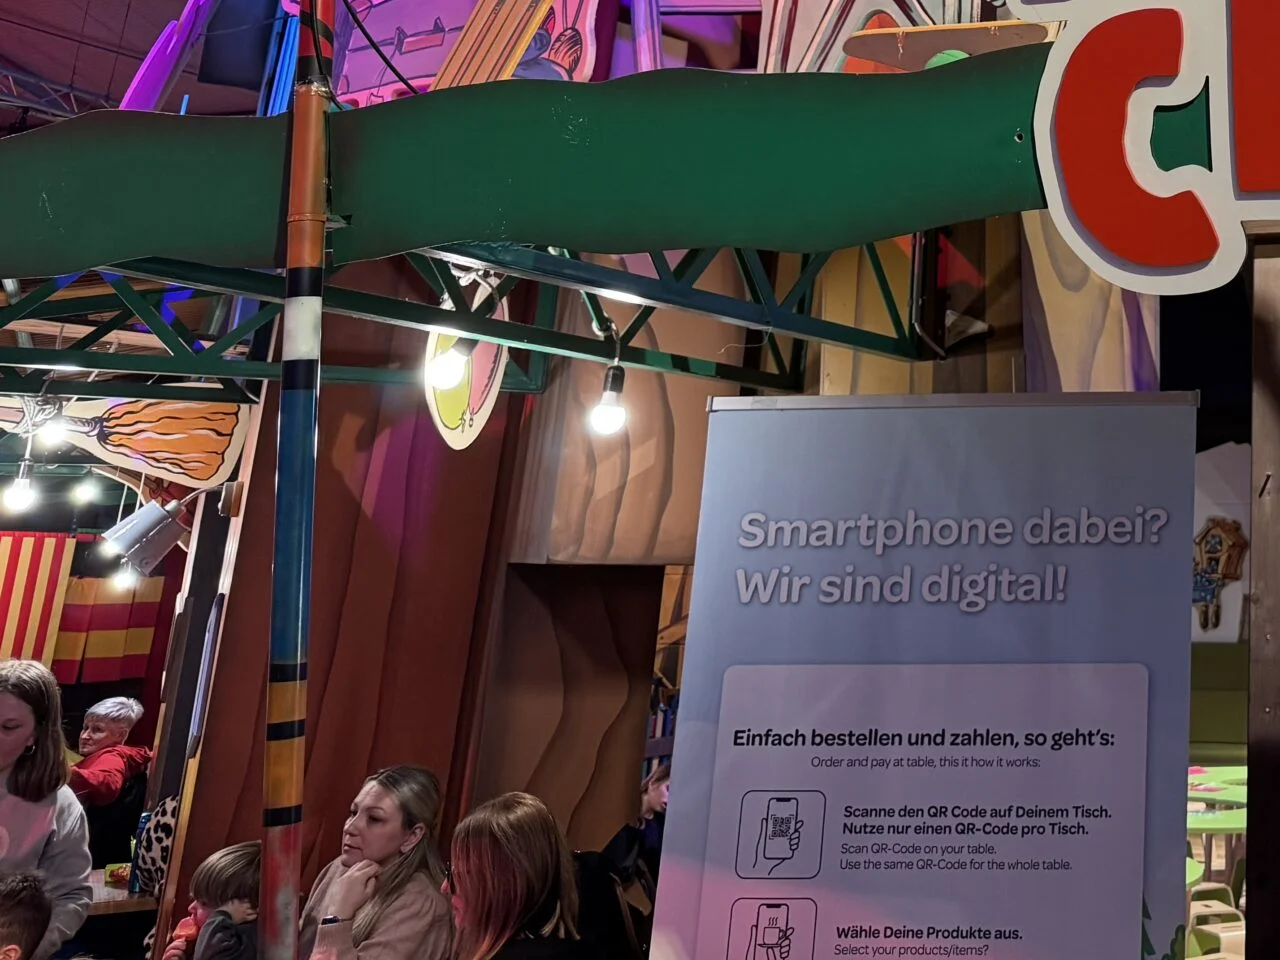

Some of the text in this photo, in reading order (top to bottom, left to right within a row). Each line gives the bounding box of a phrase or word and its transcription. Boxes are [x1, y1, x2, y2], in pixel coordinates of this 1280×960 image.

[738, 505, 1169, 556] Smartphone dabei?
[735, 562, 1068, 613] Wir sind digital!
[733, 728, 807, 747] Einfach
[811, 728, 903, 747] bestellen
[907, 728, 946, 747] und
[949, 728, 1020, 749] zahlen,
[1023, 732, 1048, 747] so
[811, 755, 1041, 770] Order and pay at table, this it how it works:
[843, 805, 1112, 819] Scanne den QR Code auf Deinem Tisch.
[842, 821, 1089, 839] Nutze nur einen QR-Code pro Tisch.
[840, 843, 998, 857] Scan QR-Code on your table.
[840, 858, 1073, 871] Use the same QR-Code for the whole table.
[836, 925, 1023, 940] Wähle Deine Produkte aus.
[834, 943, 990, 958] Select your products/items?
